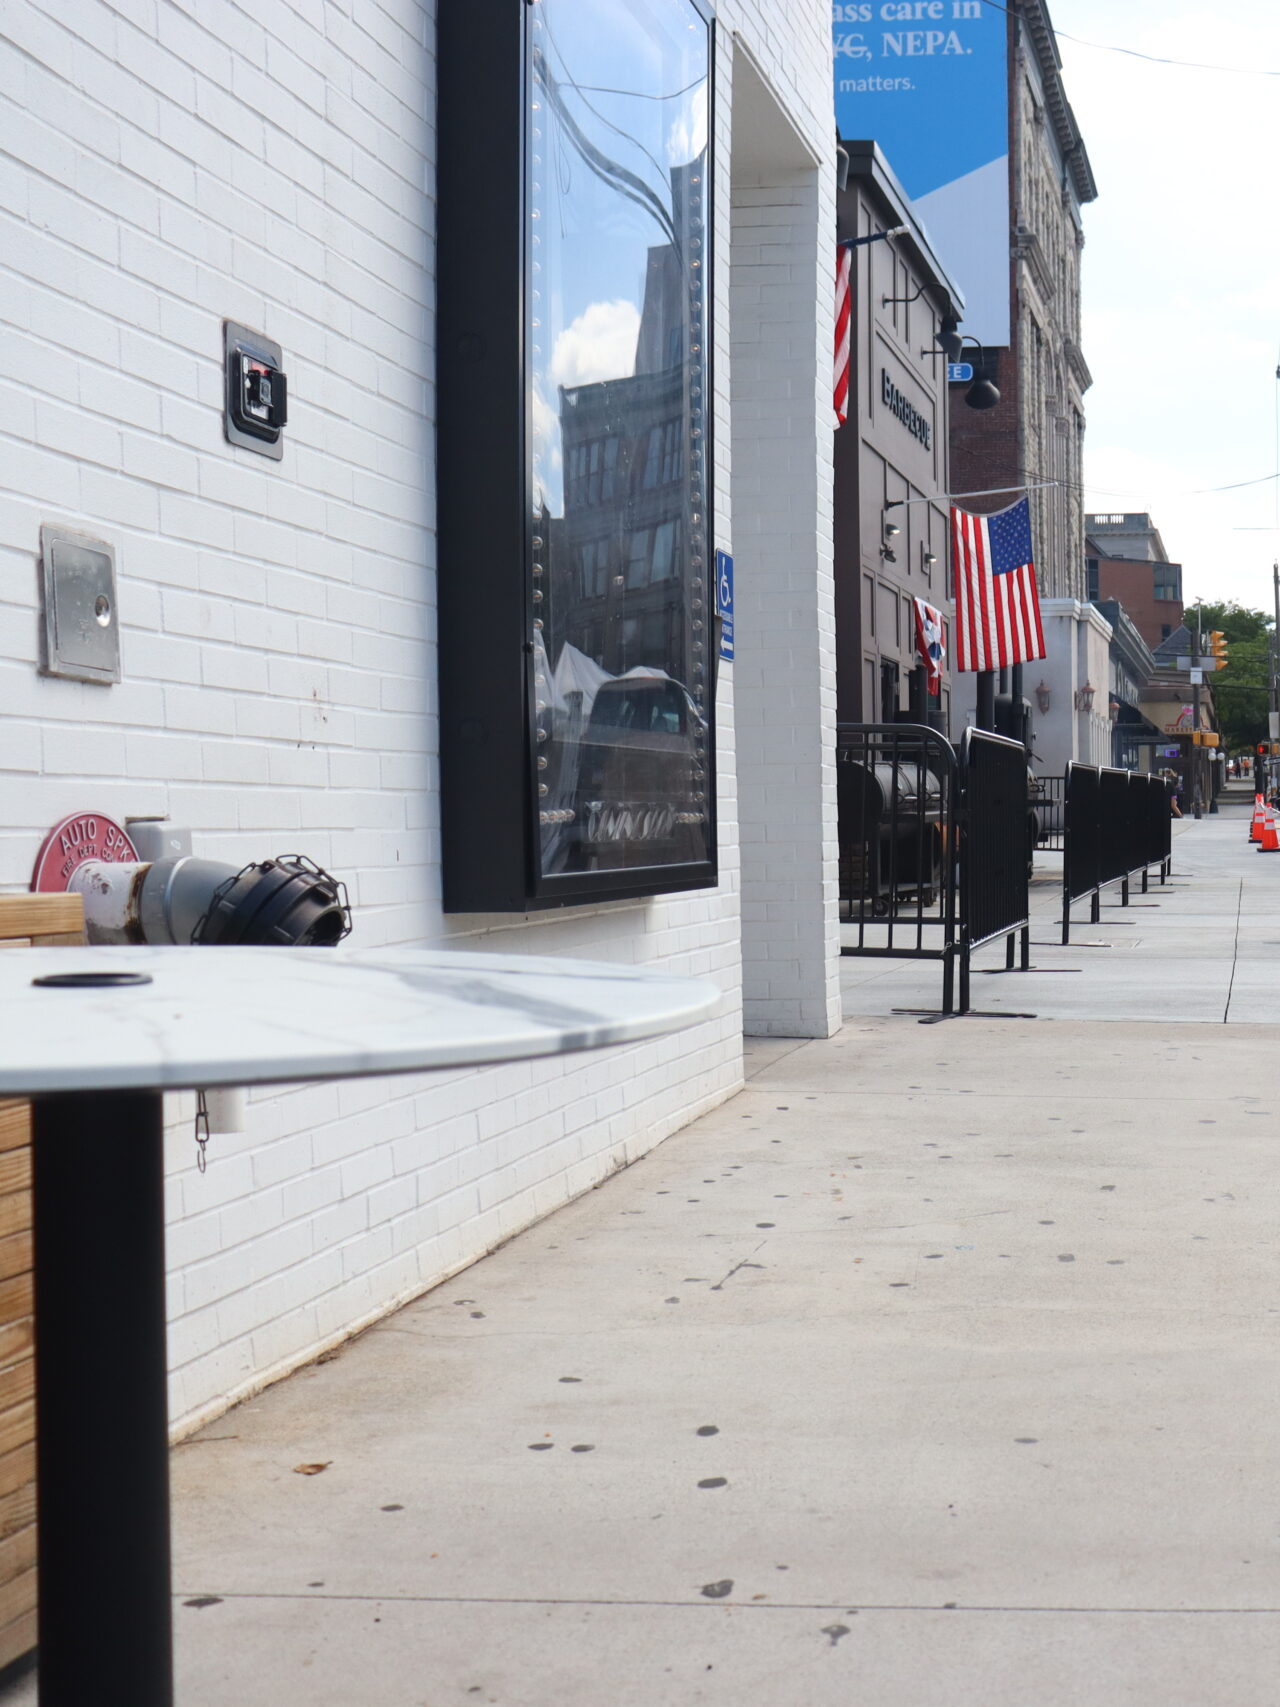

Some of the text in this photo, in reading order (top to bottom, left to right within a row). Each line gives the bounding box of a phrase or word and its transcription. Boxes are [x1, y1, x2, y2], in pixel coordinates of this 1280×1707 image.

[880, 2, 945, 21] care
[952, 0, 983, 19] in
[881, 30, 973, 57] NEPA.
[839, 76, 916, 92] matters.
[881, 367, 931, 452] BARBECUE
[60, 819, 97, 856] AUTO
